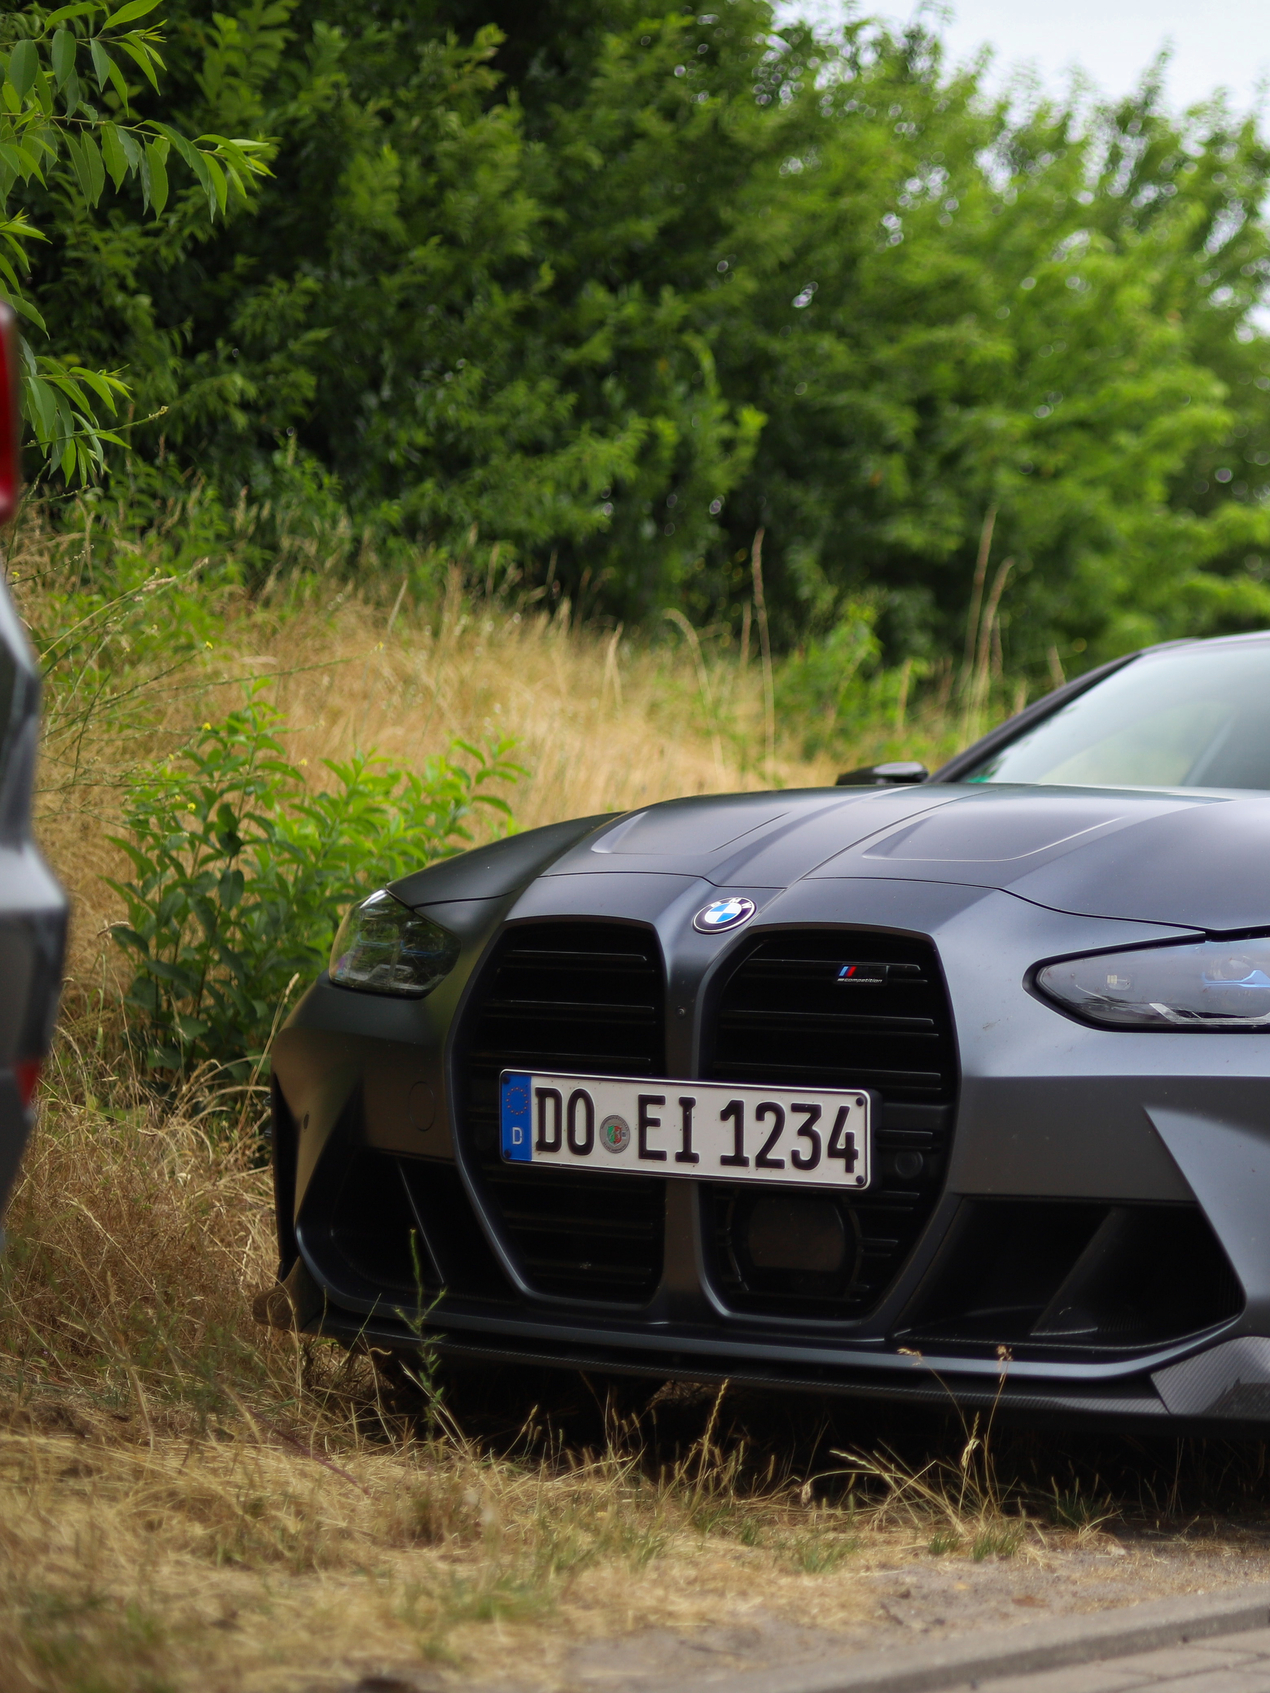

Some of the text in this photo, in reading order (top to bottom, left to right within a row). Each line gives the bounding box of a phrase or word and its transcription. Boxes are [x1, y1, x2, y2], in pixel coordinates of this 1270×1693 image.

[512, 1127, 523, 1145] D
[534, 1086, 595, 1156] DO
[638, 1093, 700, 1164] EI
[720, 1099, 859, 1174] 1234
